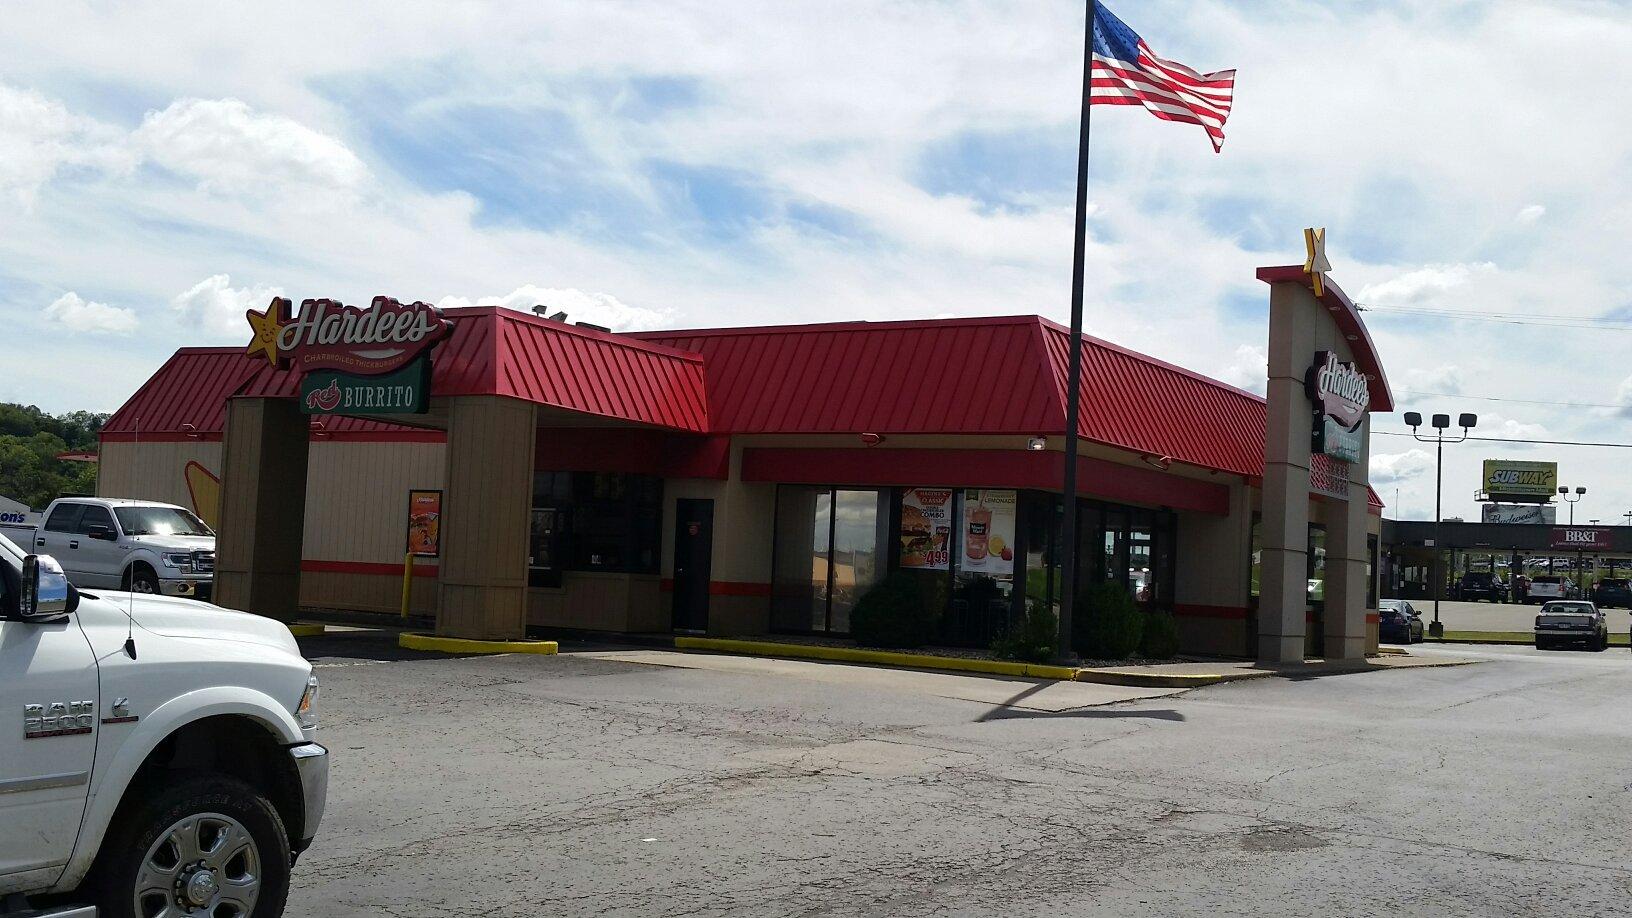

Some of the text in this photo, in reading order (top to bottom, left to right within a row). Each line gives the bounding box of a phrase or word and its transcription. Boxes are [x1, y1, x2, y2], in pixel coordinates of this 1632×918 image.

[277, 301, 438, 351] Hardee's
[1317, 352, 1370, 406] Hardee's
[344, 385, 413, 408] BURRITO
[1489, 470, 1553, 486] SUBWAY
[0, 511, 25, 523] on's
[921, 511, 945, 519] COMBO
[1490, 509, 1540, 524] Budweiser
[1565, 530, 1598, 542] BB&T
[24, 700, 93, 718] RAM
